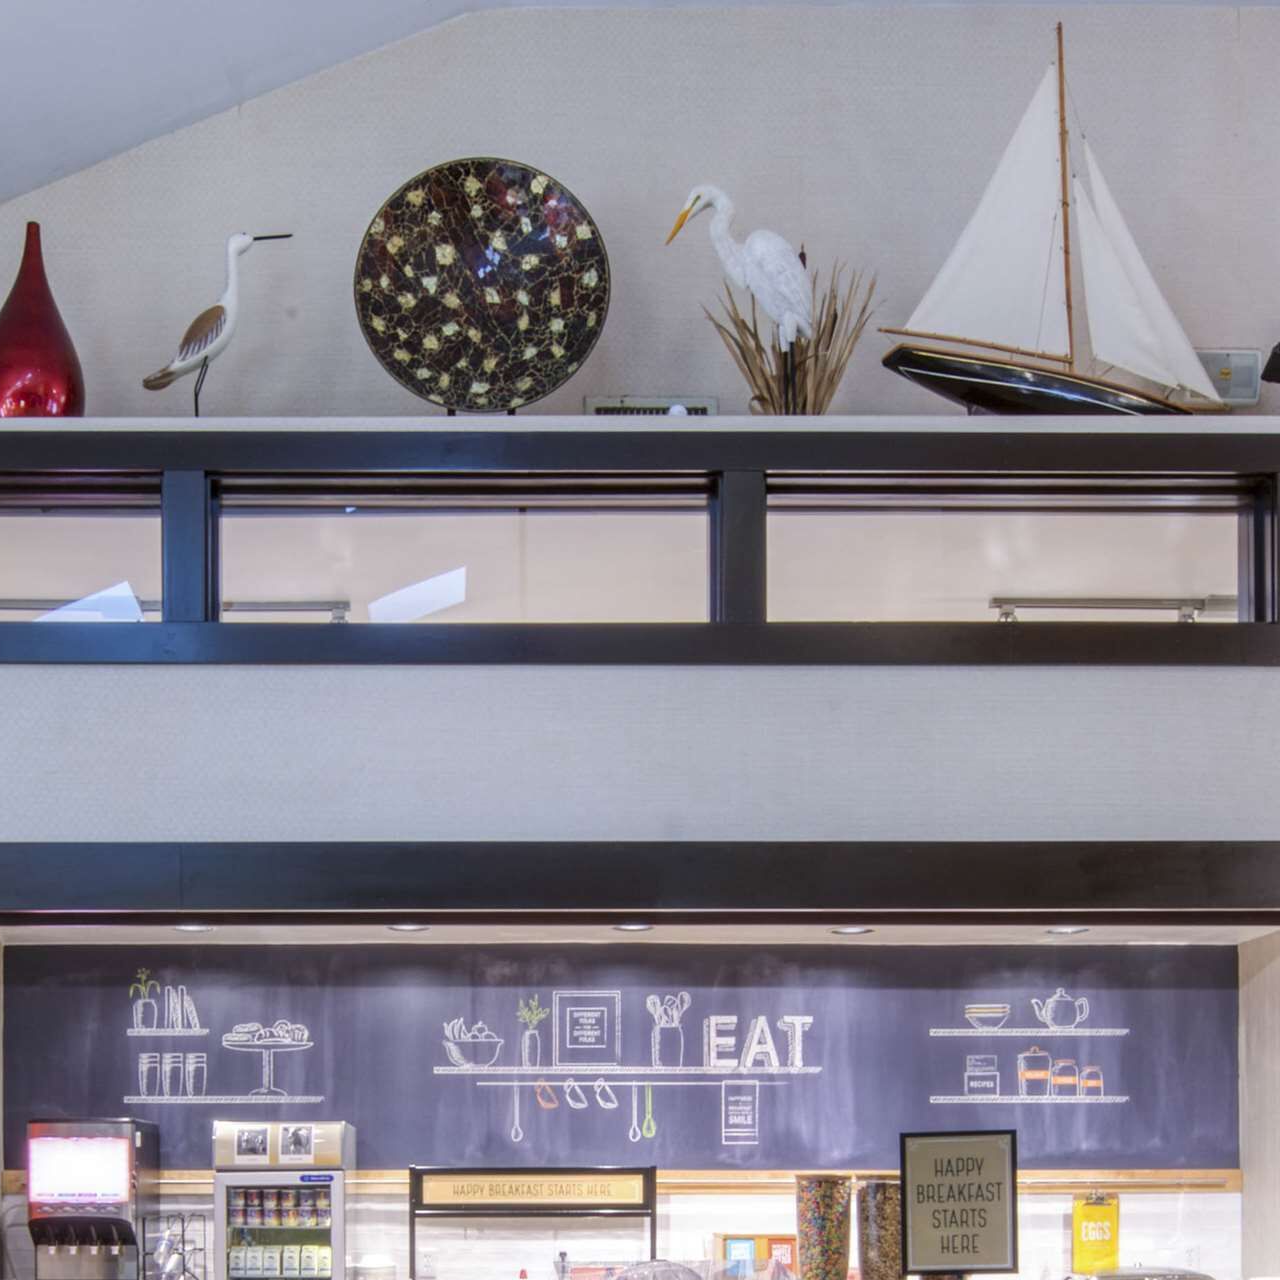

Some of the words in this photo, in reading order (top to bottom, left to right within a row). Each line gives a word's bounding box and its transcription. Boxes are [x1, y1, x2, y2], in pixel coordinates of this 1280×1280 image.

[703, 1015, 813, 1068] EAT
[969, 1079, 995, 1088] RECIPES
[728, 1115, 753, 1124] SMILE
[934, 1157, 984, 1177] HAPPY
[452, 1183, 484, 1197] HAPPY
[488, 1183, 544, 1197] BREAKFAST
[547, 1183, 583, 1197] STARTS
[586, 1183, 612, 1197] HERE
[916, 1182, 1003, 1204] BREAKFAST
[932, 1208, 987, 1229] STARTS
[1081, 1221, 1112, 1242] EGGS
[940, 1234, 981, 1254] HERE
